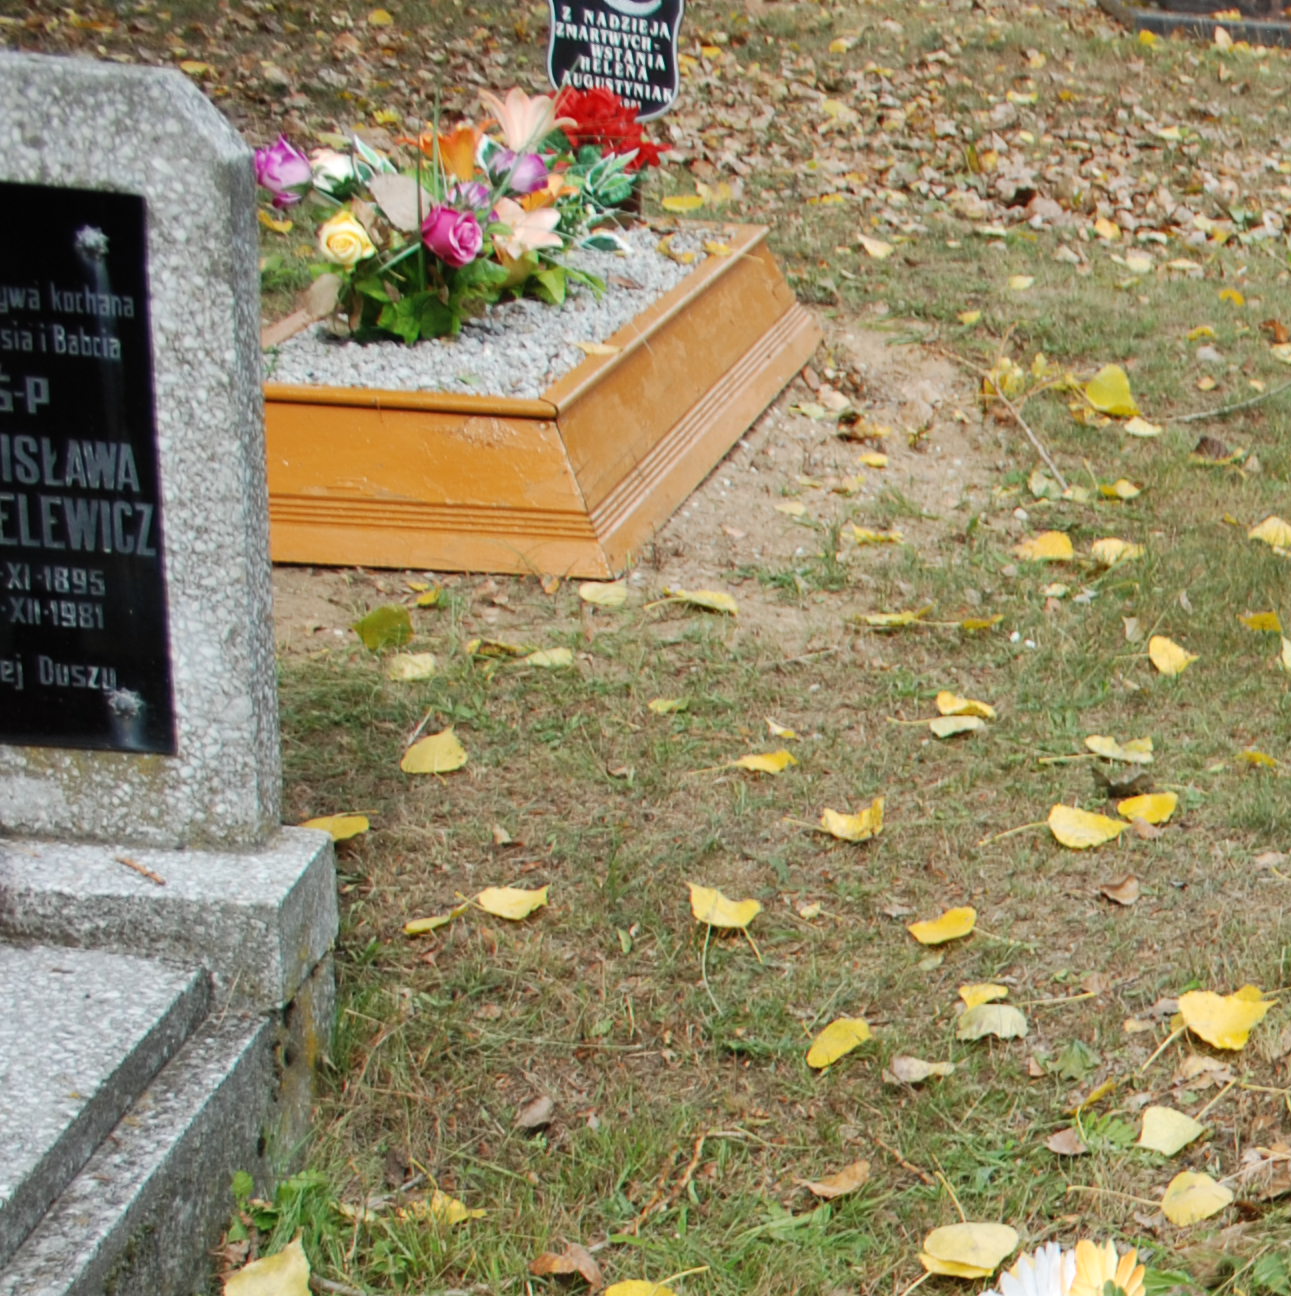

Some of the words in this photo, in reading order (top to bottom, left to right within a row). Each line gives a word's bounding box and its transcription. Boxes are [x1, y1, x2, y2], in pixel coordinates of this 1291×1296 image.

[562, 6, 571, 21] Z
[579, 54, 648, 82] HELENA
[591, 43, 666, 71] WSTANIA
[51, 281, 134, 317] kochana
[41, 324, 47, 351] i
[53, 323, 121, 360] Babcia
[0, 434, 140, 492] ISŁAWA
[0, 492, 157, 556] ELEWICZ
[38, 655, 117, 695] Duszy
